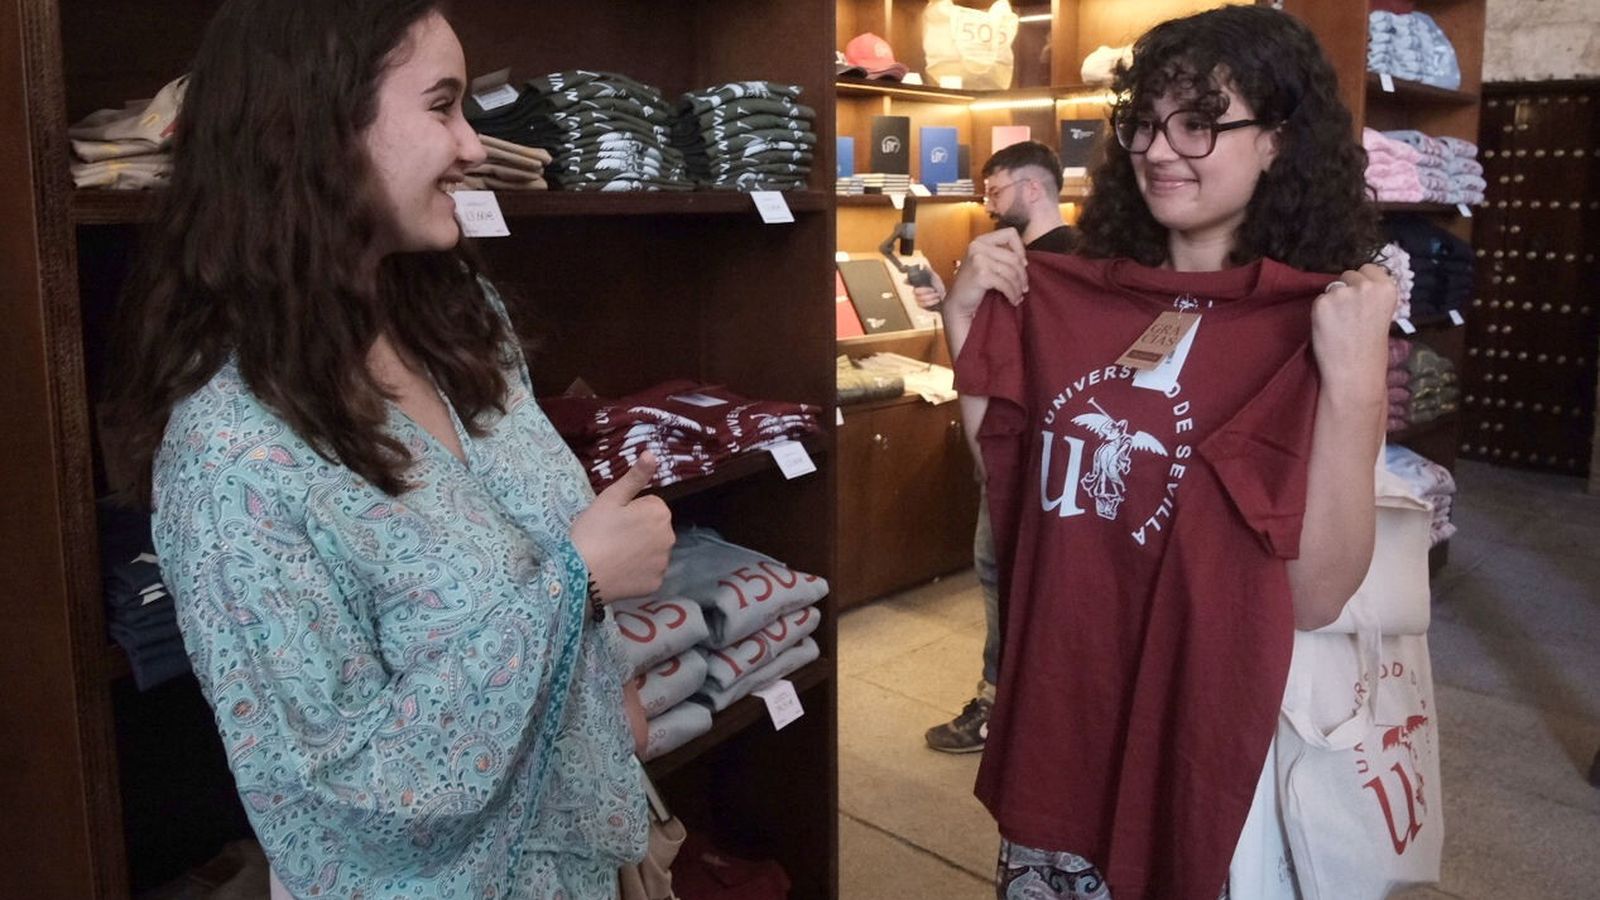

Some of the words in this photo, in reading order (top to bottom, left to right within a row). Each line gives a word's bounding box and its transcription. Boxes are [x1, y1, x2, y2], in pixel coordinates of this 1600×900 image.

[1044, 364, 1181, 425] UNIVERSD
[1172, 401, 1194, 434] DE
[1131, 444, 1192, 546] SEVILLA
[717, 561, 818, 610] 150
